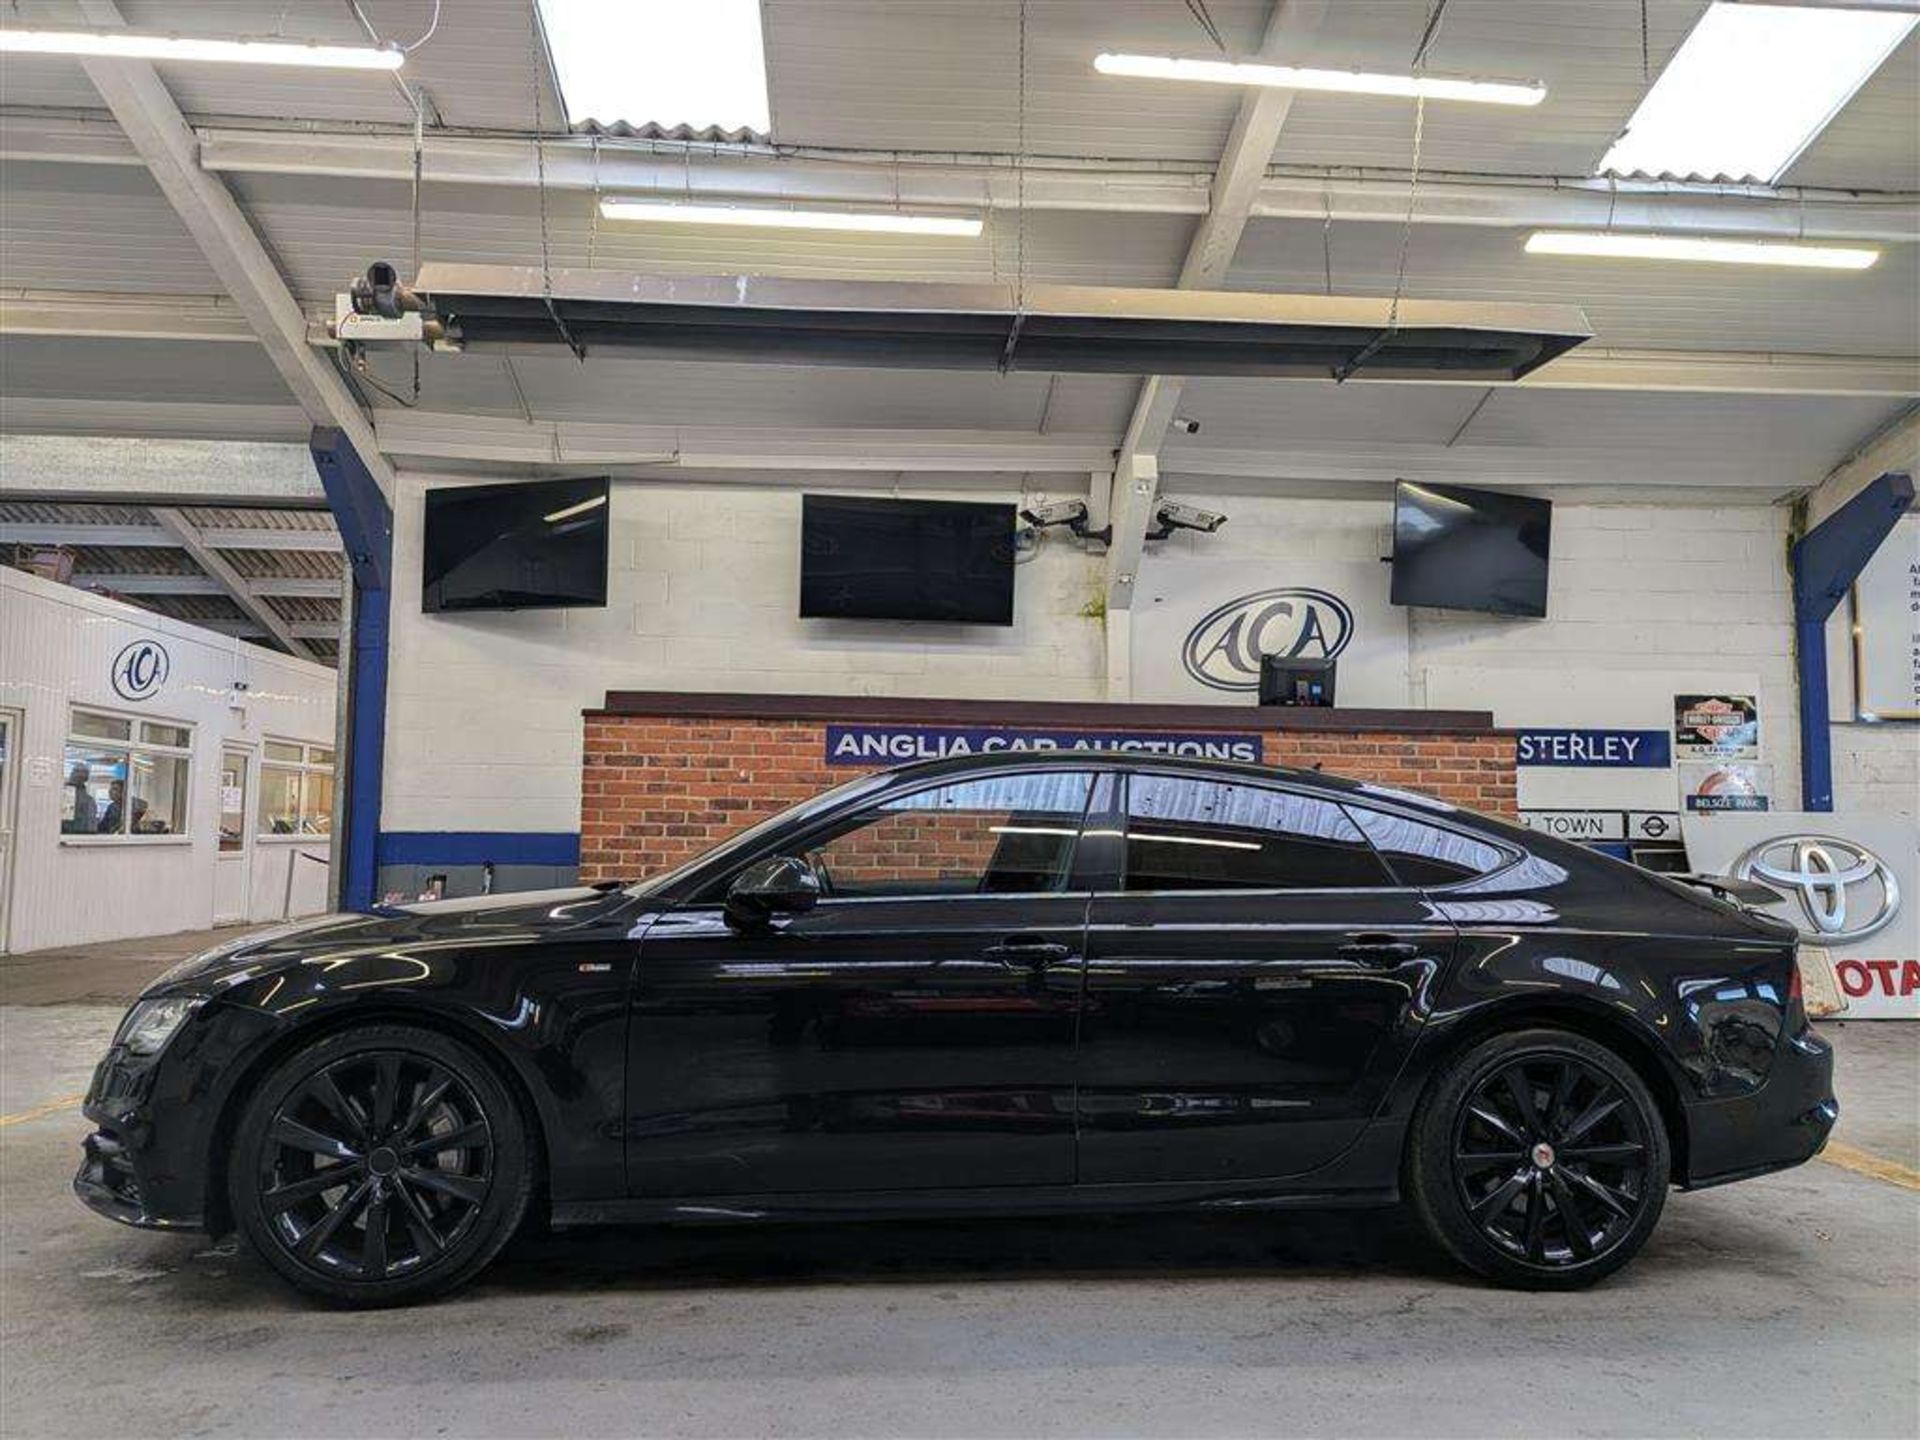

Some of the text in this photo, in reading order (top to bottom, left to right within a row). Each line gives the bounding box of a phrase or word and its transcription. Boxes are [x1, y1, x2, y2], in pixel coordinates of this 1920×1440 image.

[1198, 601, 1331, 674] ACA
[834, 733, 972, 759] ANGLIA
[1519, 735, 1639, 760] STERLEY
[1543, 816, 1603, 833] TOWN
